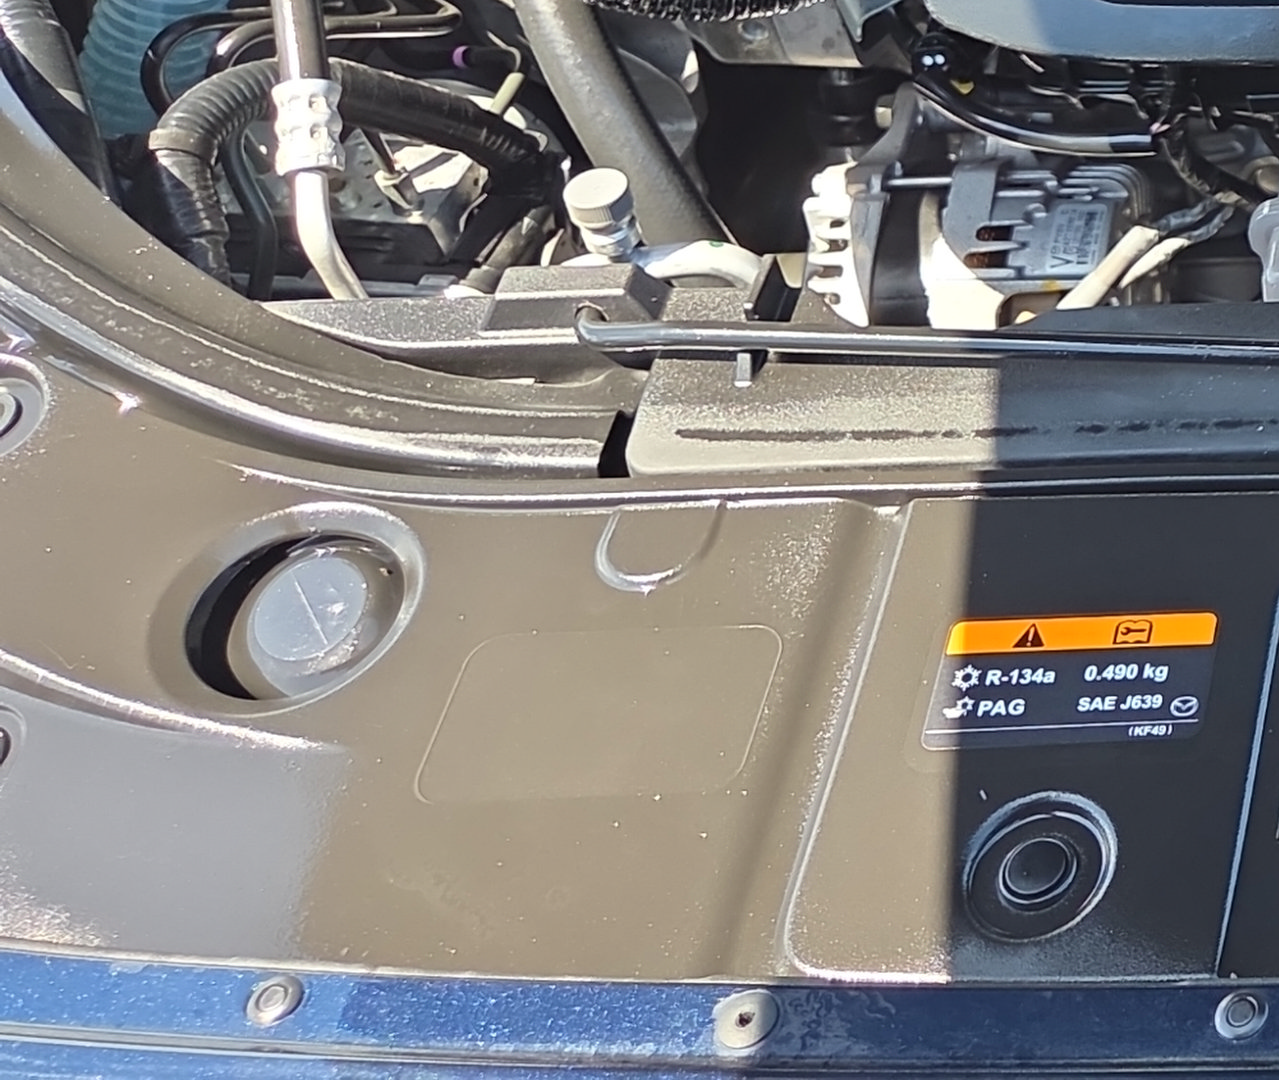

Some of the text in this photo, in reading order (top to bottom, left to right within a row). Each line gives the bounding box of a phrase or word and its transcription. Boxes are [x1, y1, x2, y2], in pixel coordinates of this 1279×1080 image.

[985, 668, 1056, 686] R-134a
[1083, 662, 1169, 682] 0.490 kg
[976, 698, 1026, 717] PAG
[1076, 694, 1163, 712] SAE J639
